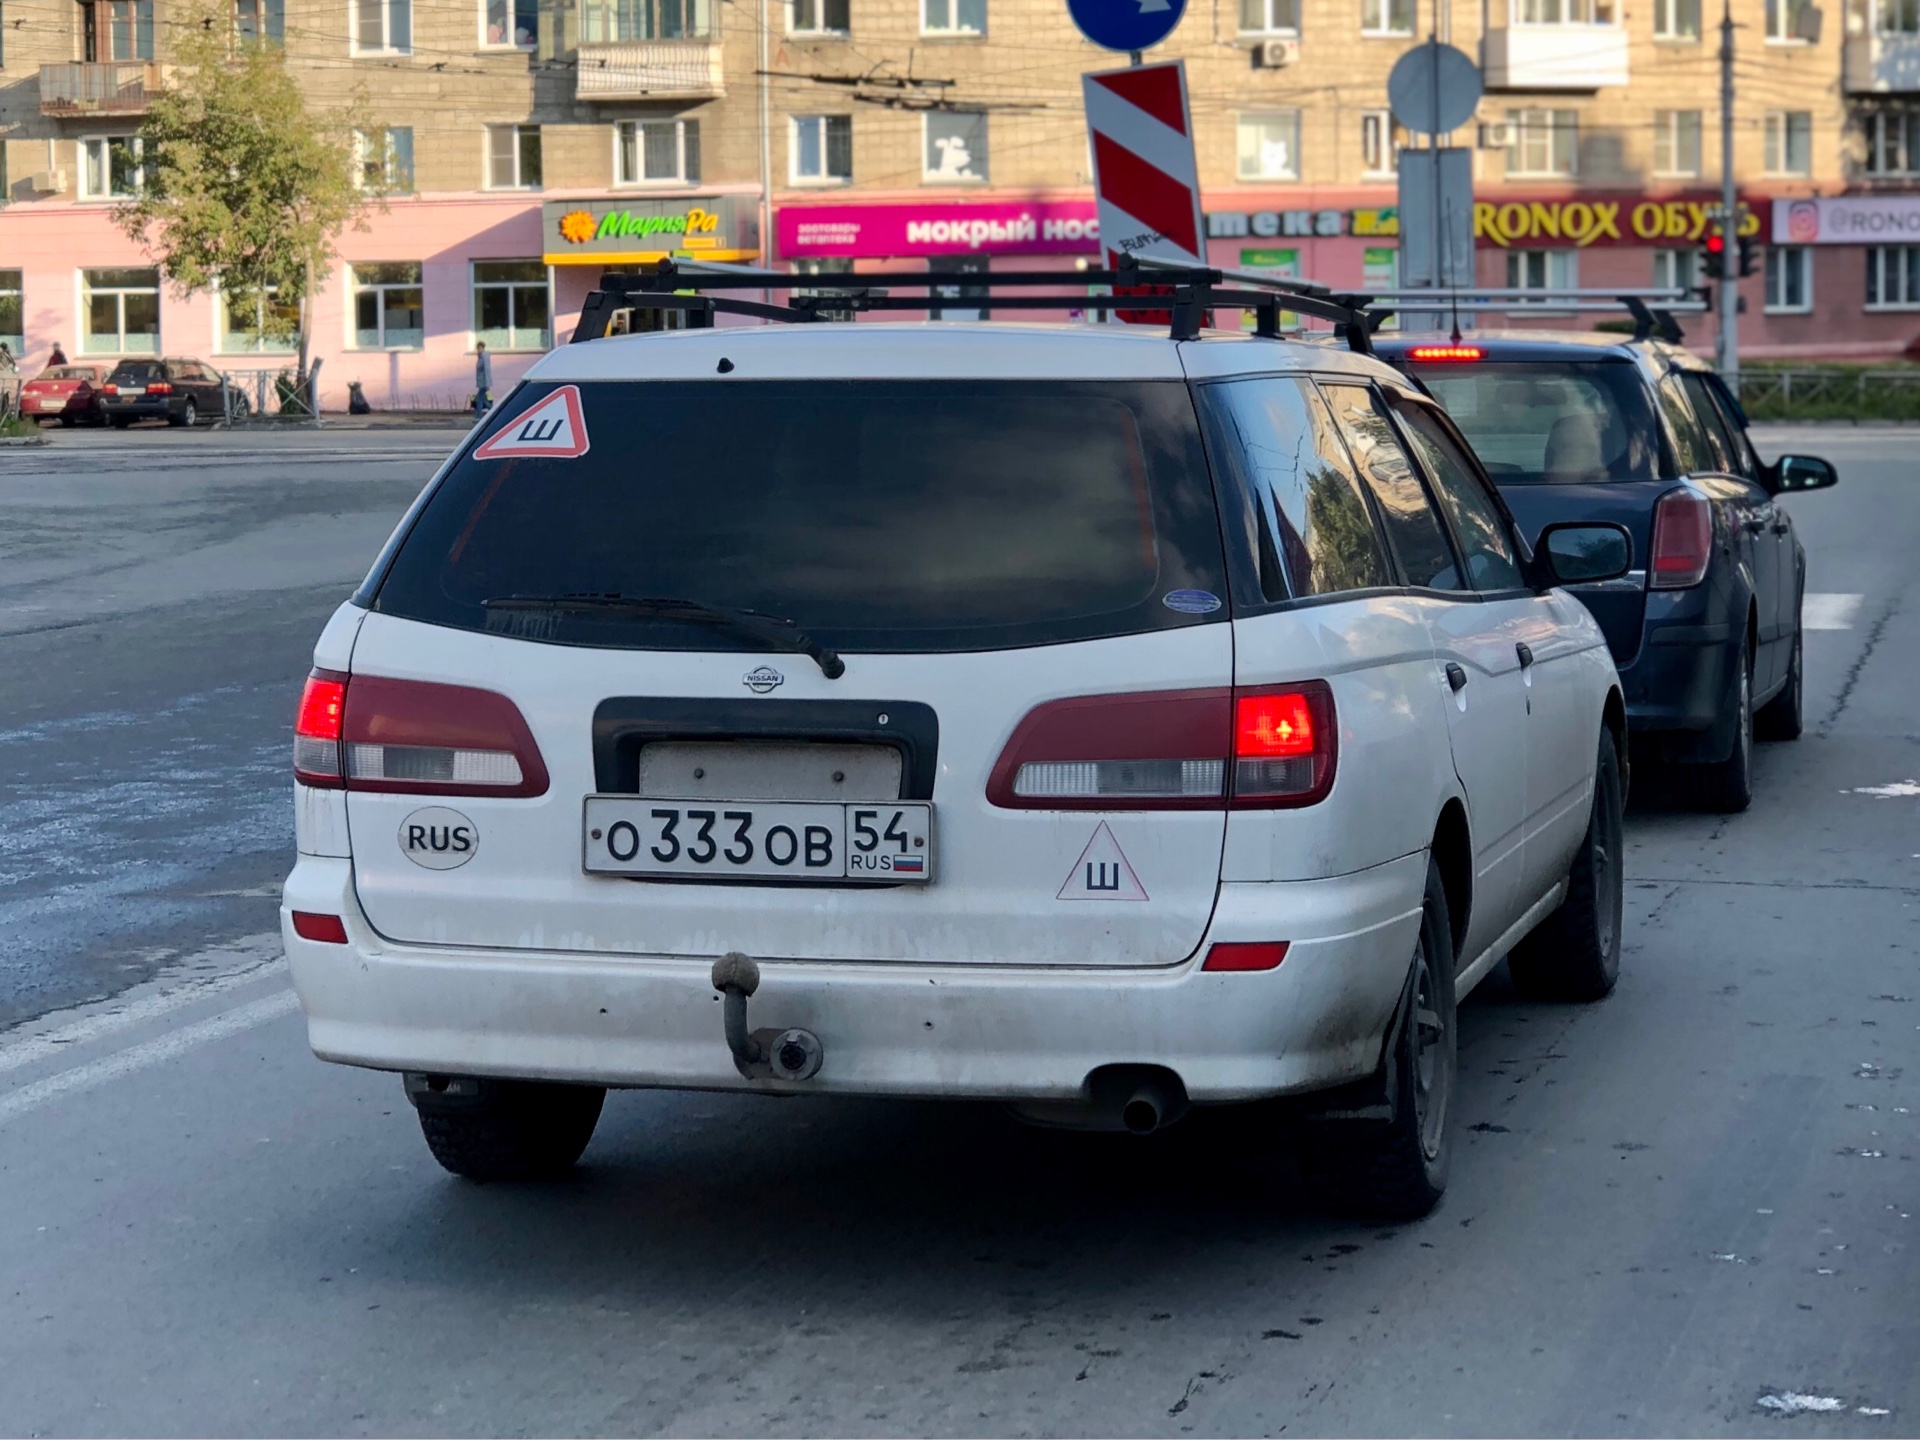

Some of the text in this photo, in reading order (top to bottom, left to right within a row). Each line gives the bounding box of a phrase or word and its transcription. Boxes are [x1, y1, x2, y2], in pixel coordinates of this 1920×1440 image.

[907, 212, 1099, 248] мокрый нос
[1474, 202, 1622, 247] RONOX
[517, 419, 564, 441] Ш
[408, 825, 471, 851] RUS
[854, 810, 908, 853] 54
[851, 854, 892, 871] RUS
[1087, 862, 1119, 890] Ш
